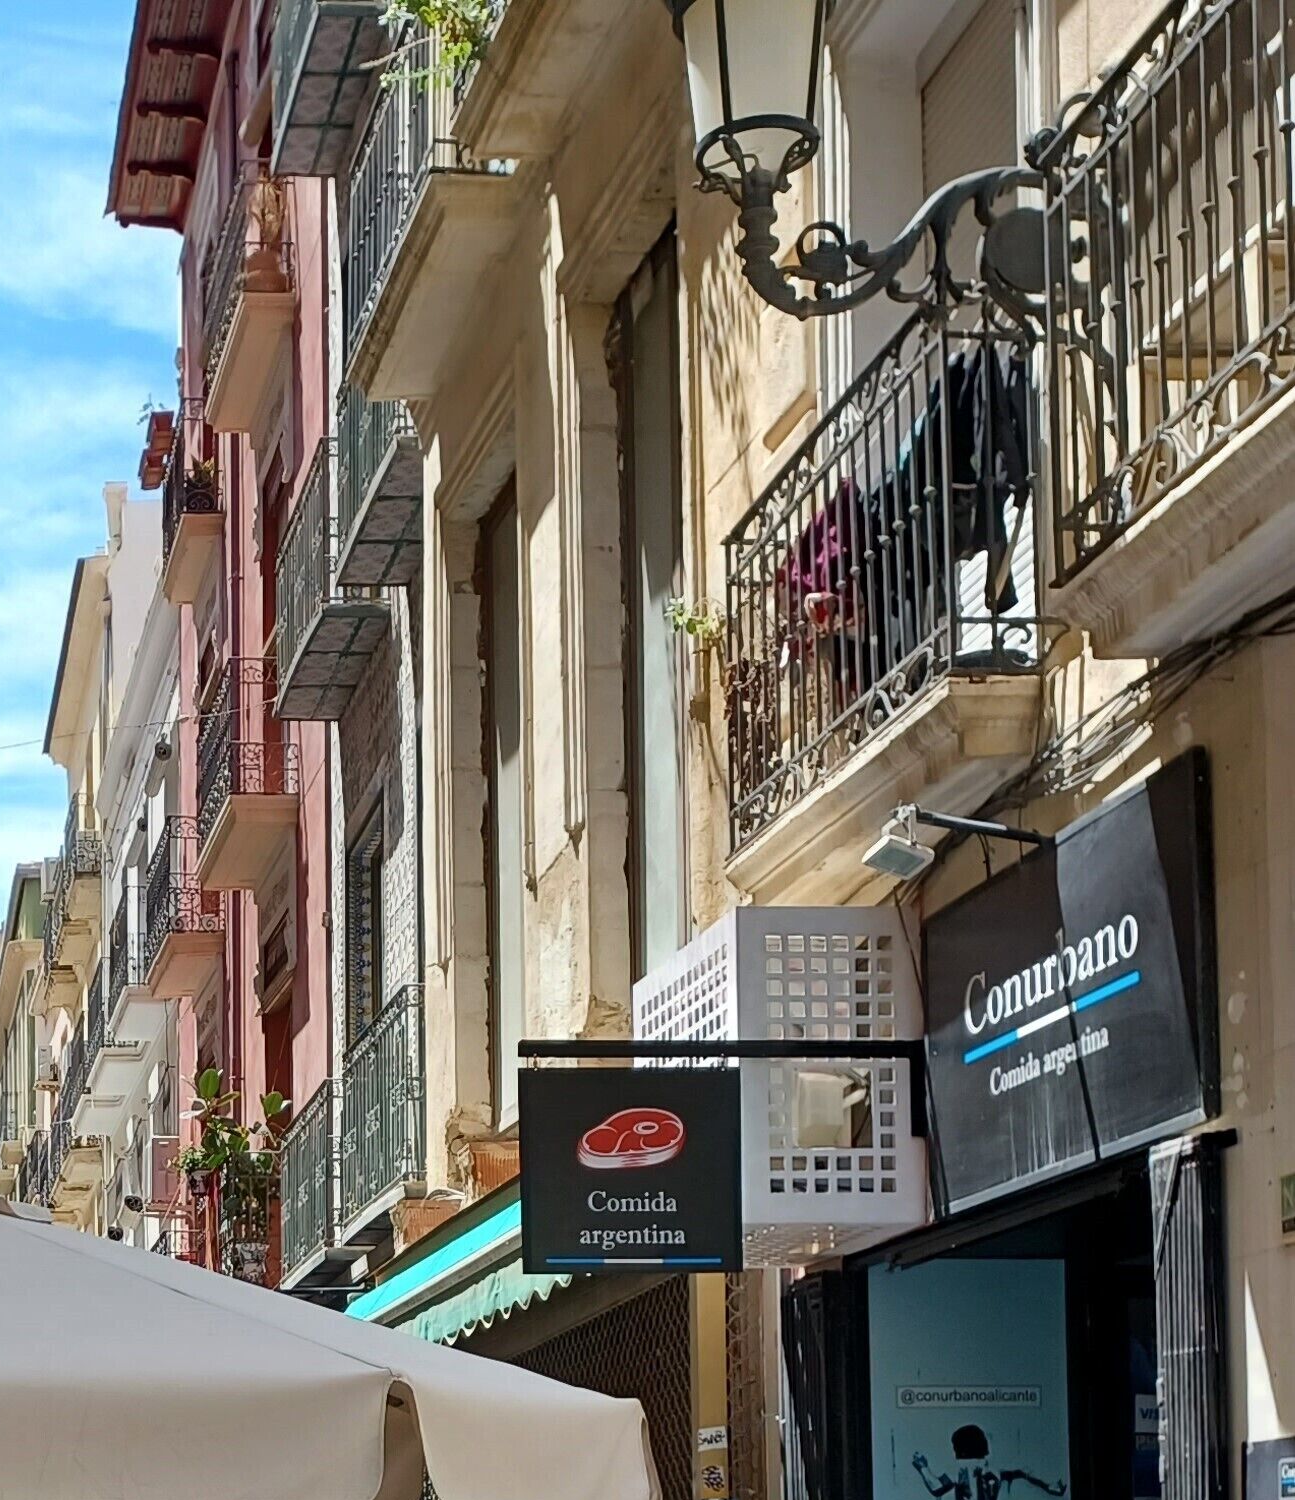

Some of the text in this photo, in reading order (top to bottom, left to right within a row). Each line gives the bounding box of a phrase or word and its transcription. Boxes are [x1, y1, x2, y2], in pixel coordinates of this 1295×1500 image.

[964, 914, 1139, 1034] Conurbano
[989, 1052, 1041, 1096] Comida
[587, 1190, 678, 1212] Comida
[579, 1224, 686, 1250] argentina
[901, 1388, 1037, 1405] @conurbanoalicante
